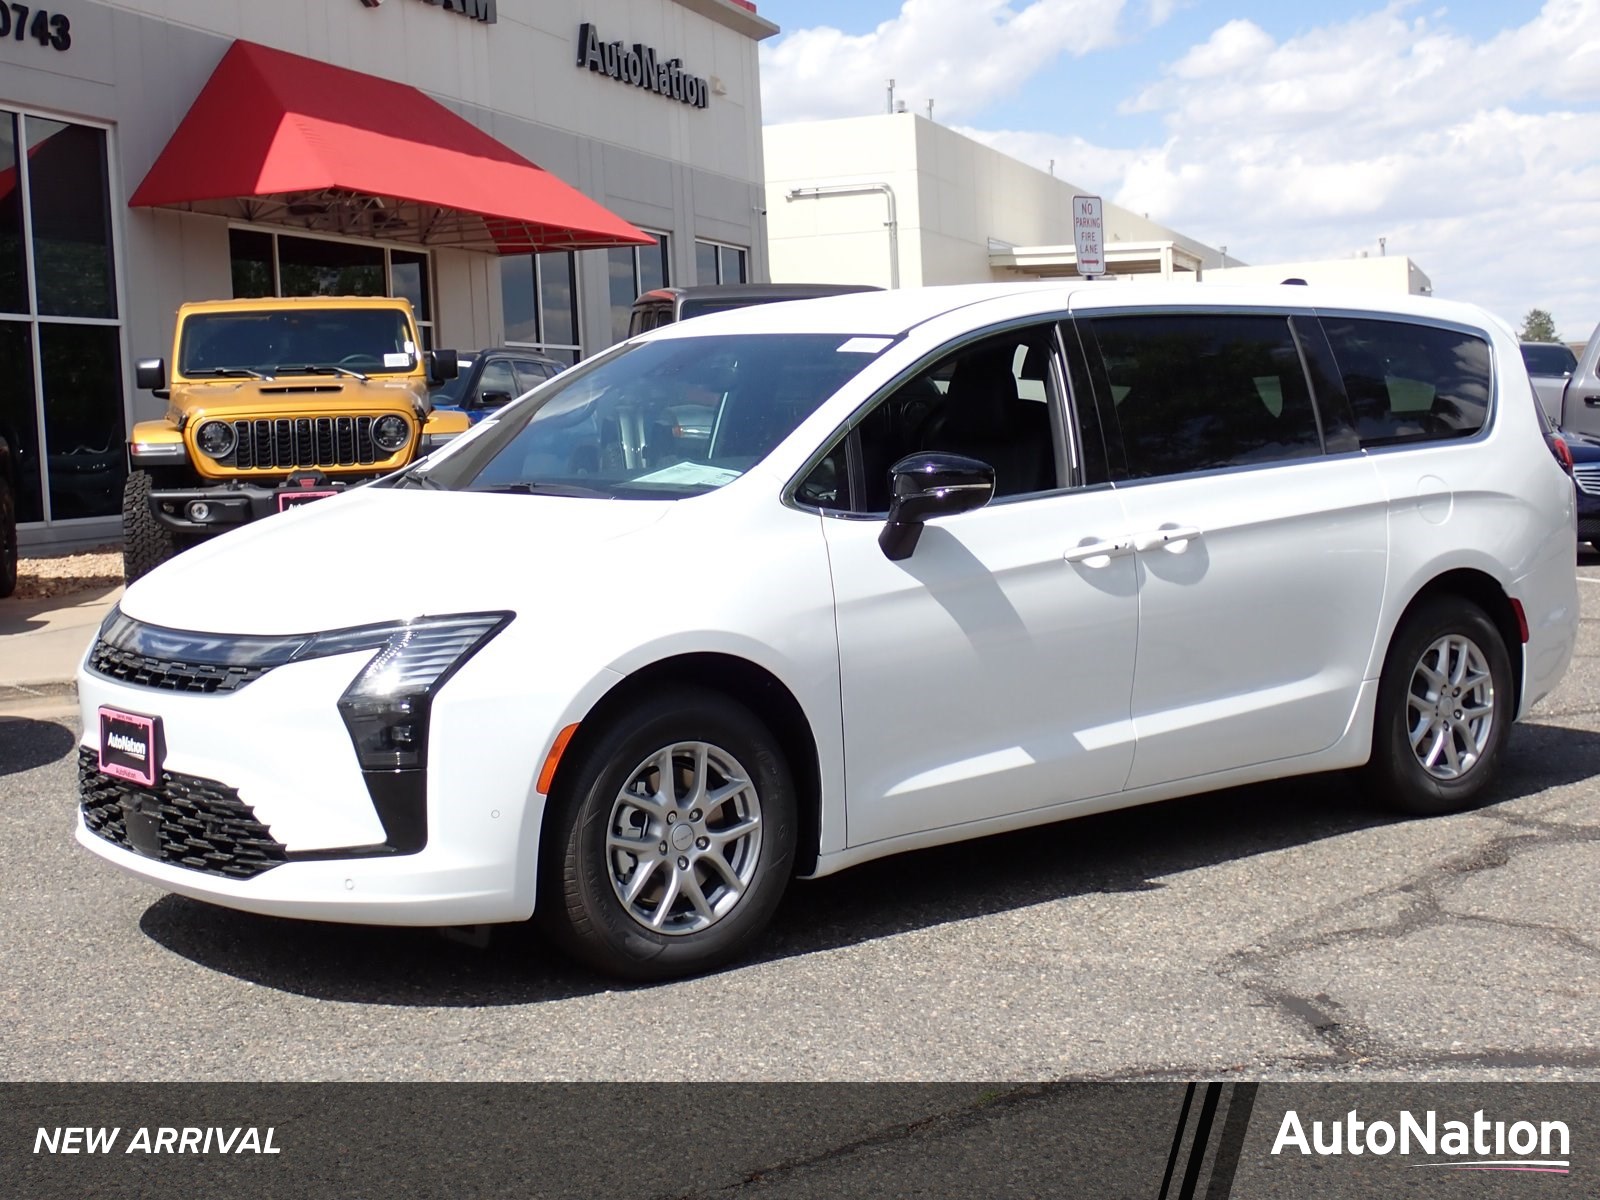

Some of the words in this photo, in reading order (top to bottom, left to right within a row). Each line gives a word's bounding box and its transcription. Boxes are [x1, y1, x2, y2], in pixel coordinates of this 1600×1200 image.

[576, 22, 709, 109] AutoNation
[1081, 203, 1093, 215] NO
[1075, 217, 1101, 228] PARKING
[1081, 231, 1096, 242] FIRE
[1080, 244, 1099, 254] LANE
[107, 731, 146, 755] AutoNation
